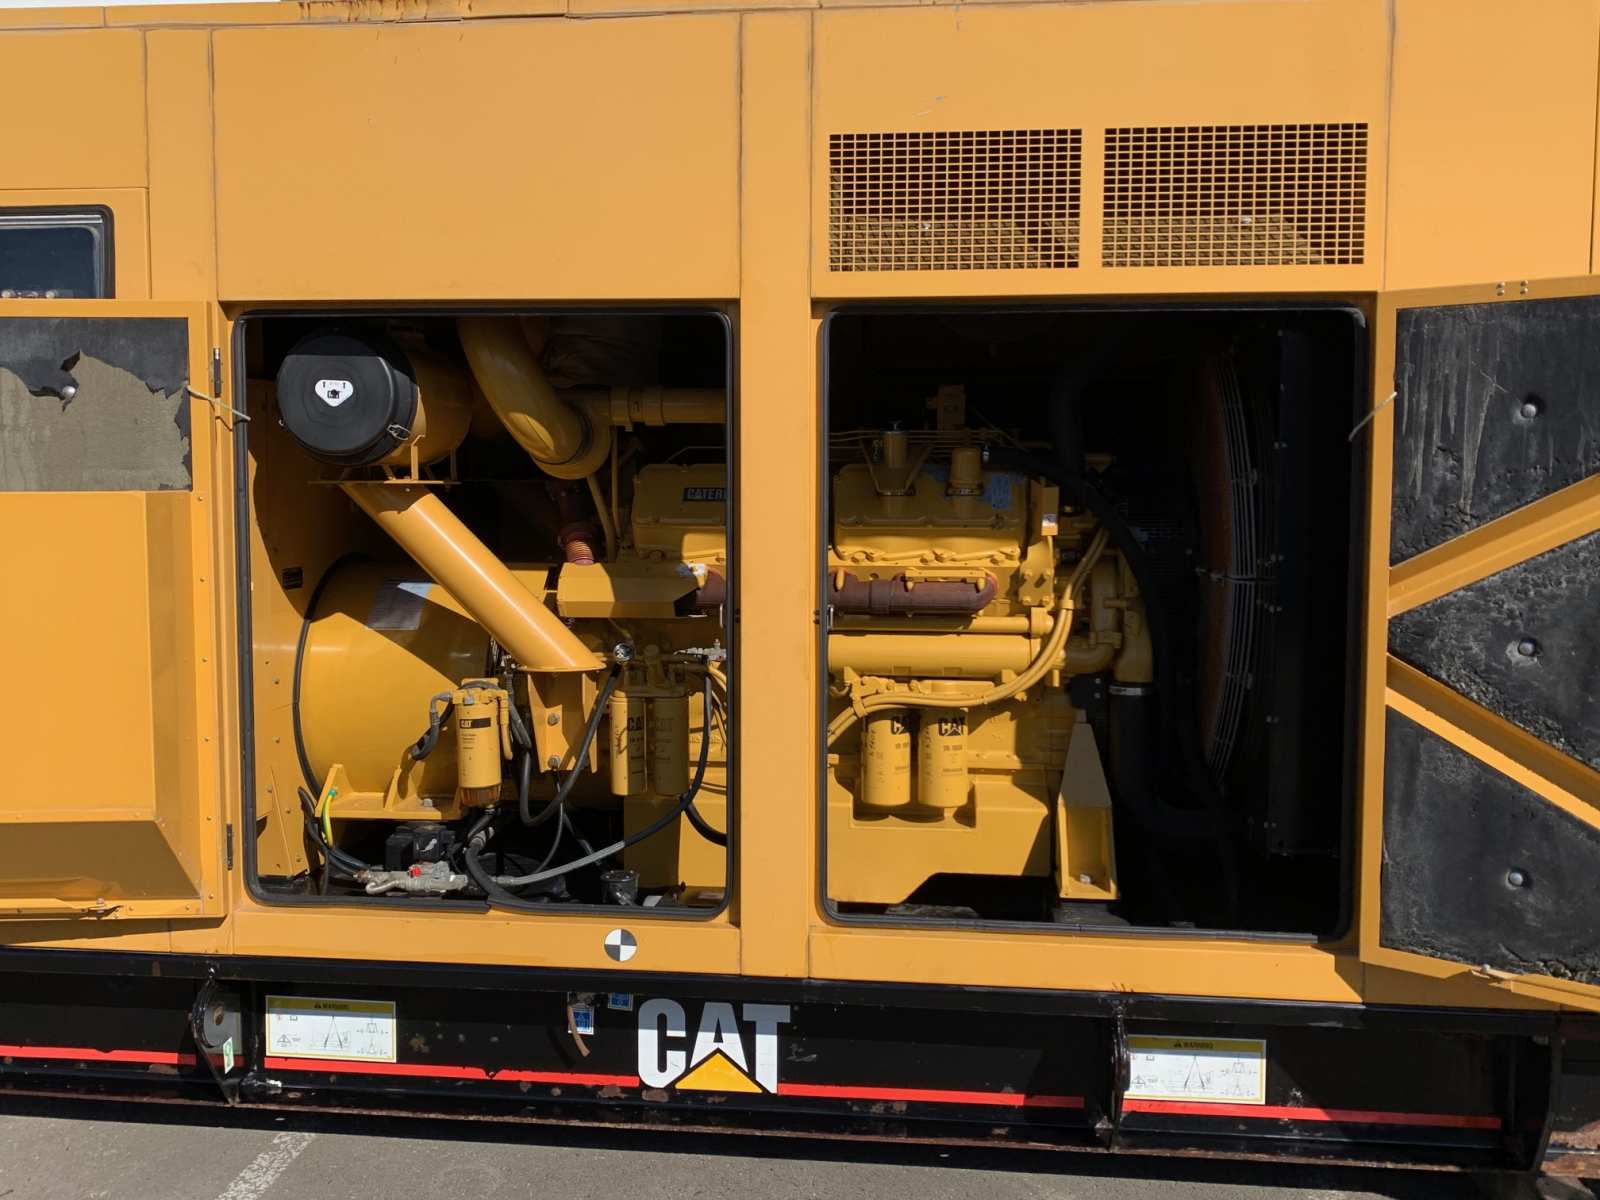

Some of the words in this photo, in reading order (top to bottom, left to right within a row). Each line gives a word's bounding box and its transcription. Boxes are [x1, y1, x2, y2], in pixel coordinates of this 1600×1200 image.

[687, 488, 726, 500] CATER
[938, 716, 966, 736] CAT
[638, 998, 791, 1094] CAT
